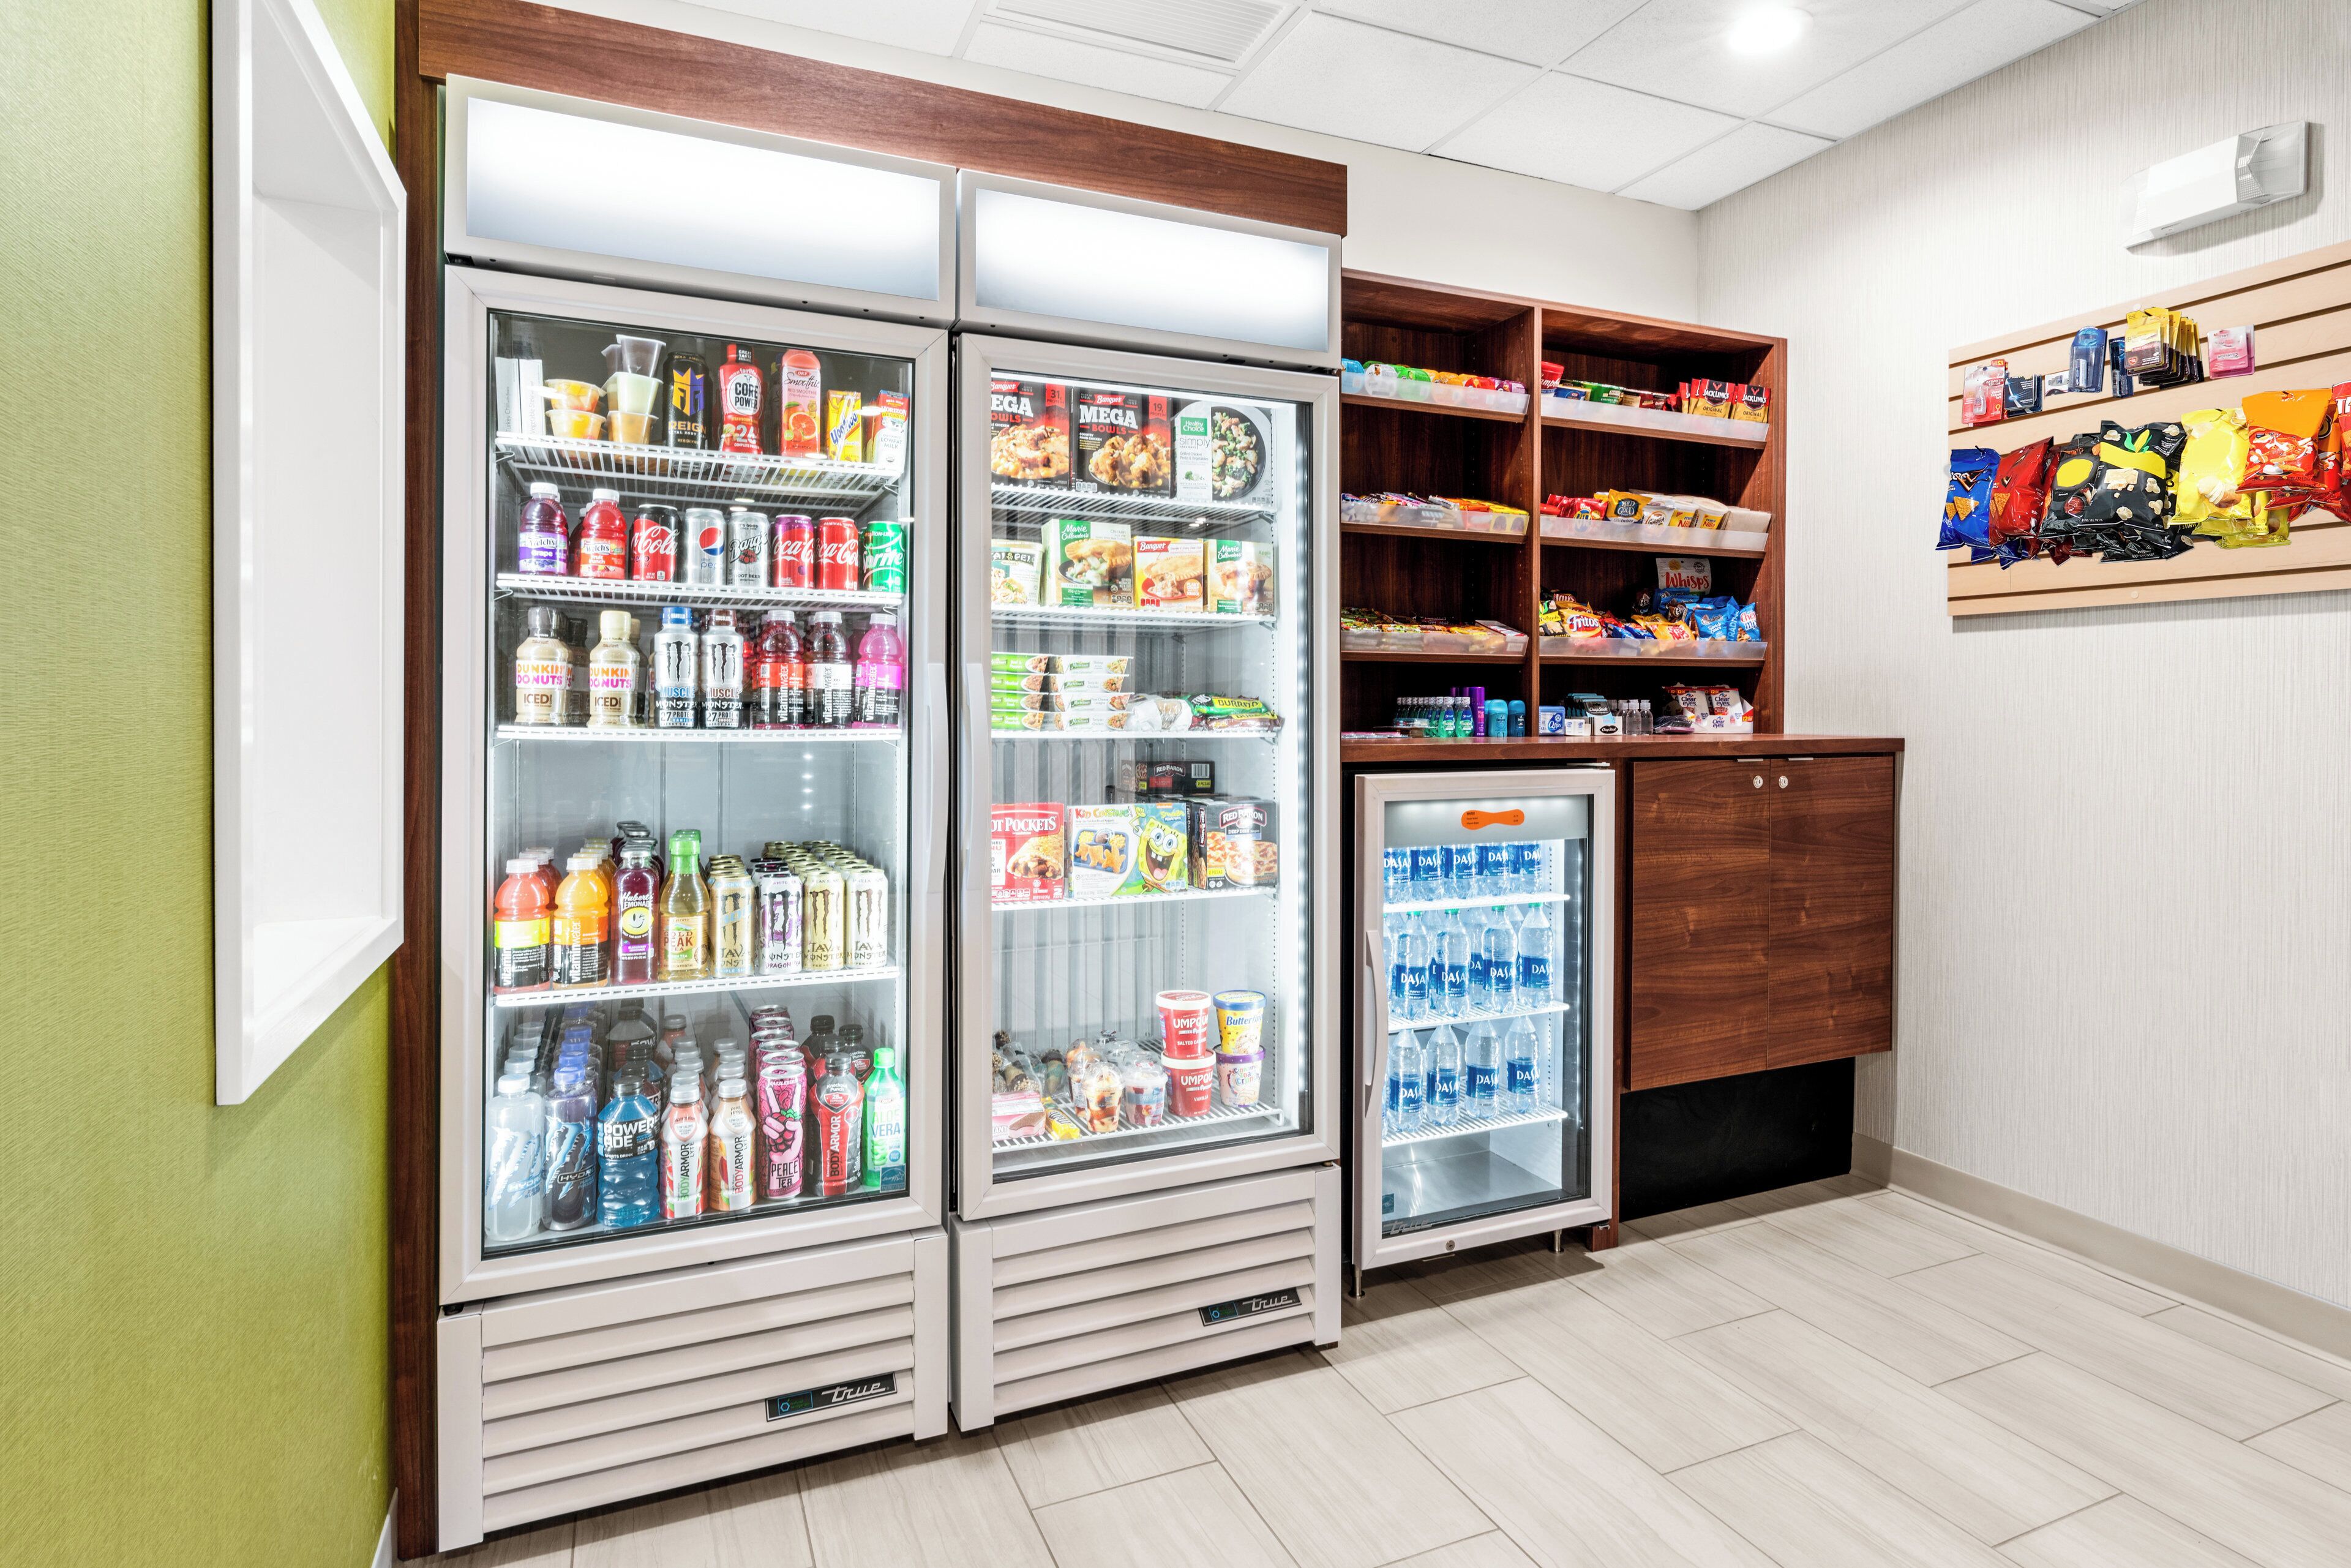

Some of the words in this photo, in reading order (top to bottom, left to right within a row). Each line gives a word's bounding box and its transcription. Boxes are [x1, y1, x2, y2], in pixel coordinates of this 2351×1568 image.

[735, 382, 759, 398] CORE
[1715, 391, 1730, 399] LINK'S
[735, 397, 758, 409] POWER
[1096, 394, 1122, 404] Banquet
[882, 406, 907, 416] HORIZON
[991, 395, 1033, 417] EGA
[991, 414, 1021, 423] OWLS
[1079, 405, 1138, 429] MEGA
[668, 421, 706, 434] REIGN
[1092, 424, 1126, 435] BOWLS
[1180, 437, 1211, 449] simply
[1062, 524, 1087, 534] Marie
[1062, 531, 1090, 541] Callender's
[1140, 542, 1166, 551] Banquet
[1661, 572, 1709, 590] Whisps
[1567, 614, 1599, 632] Fritos
[517, 675, 563, 685] DONUTS
[590, 678, 632, 688] DONUTS
[660, 685, 695, 699] MUSCLE
[523, 694, 550, 705] ICED
[594, 697, 618, 707] ICED
[1218, 699, 1259, 708] BURRITO
[1166, 765, 1183, 773] BARON
[1223, 812, 1238, 824] RED
[1238, 808, 1264, 822] BARON
[1005, 816, 1057, 833] POCKETS
[664, 937, 693, 947] PEAK
[1401, 972, 1426, 987] DASA
[604, 1117, 654, 1137] POWER
[871, 1122, 901, 1139] VERA
[604, 1135, 634, 1149] ADE
[830, 1115, 841, 1177] BODYARMOR
[680, 1142, 689, 1201] BODYARMOR
[735, 1136, 743, 1195] BODYARMOR
[771, 1160, 798, 1177] PEACE
[778, 1177, 792, 1188] TEA
